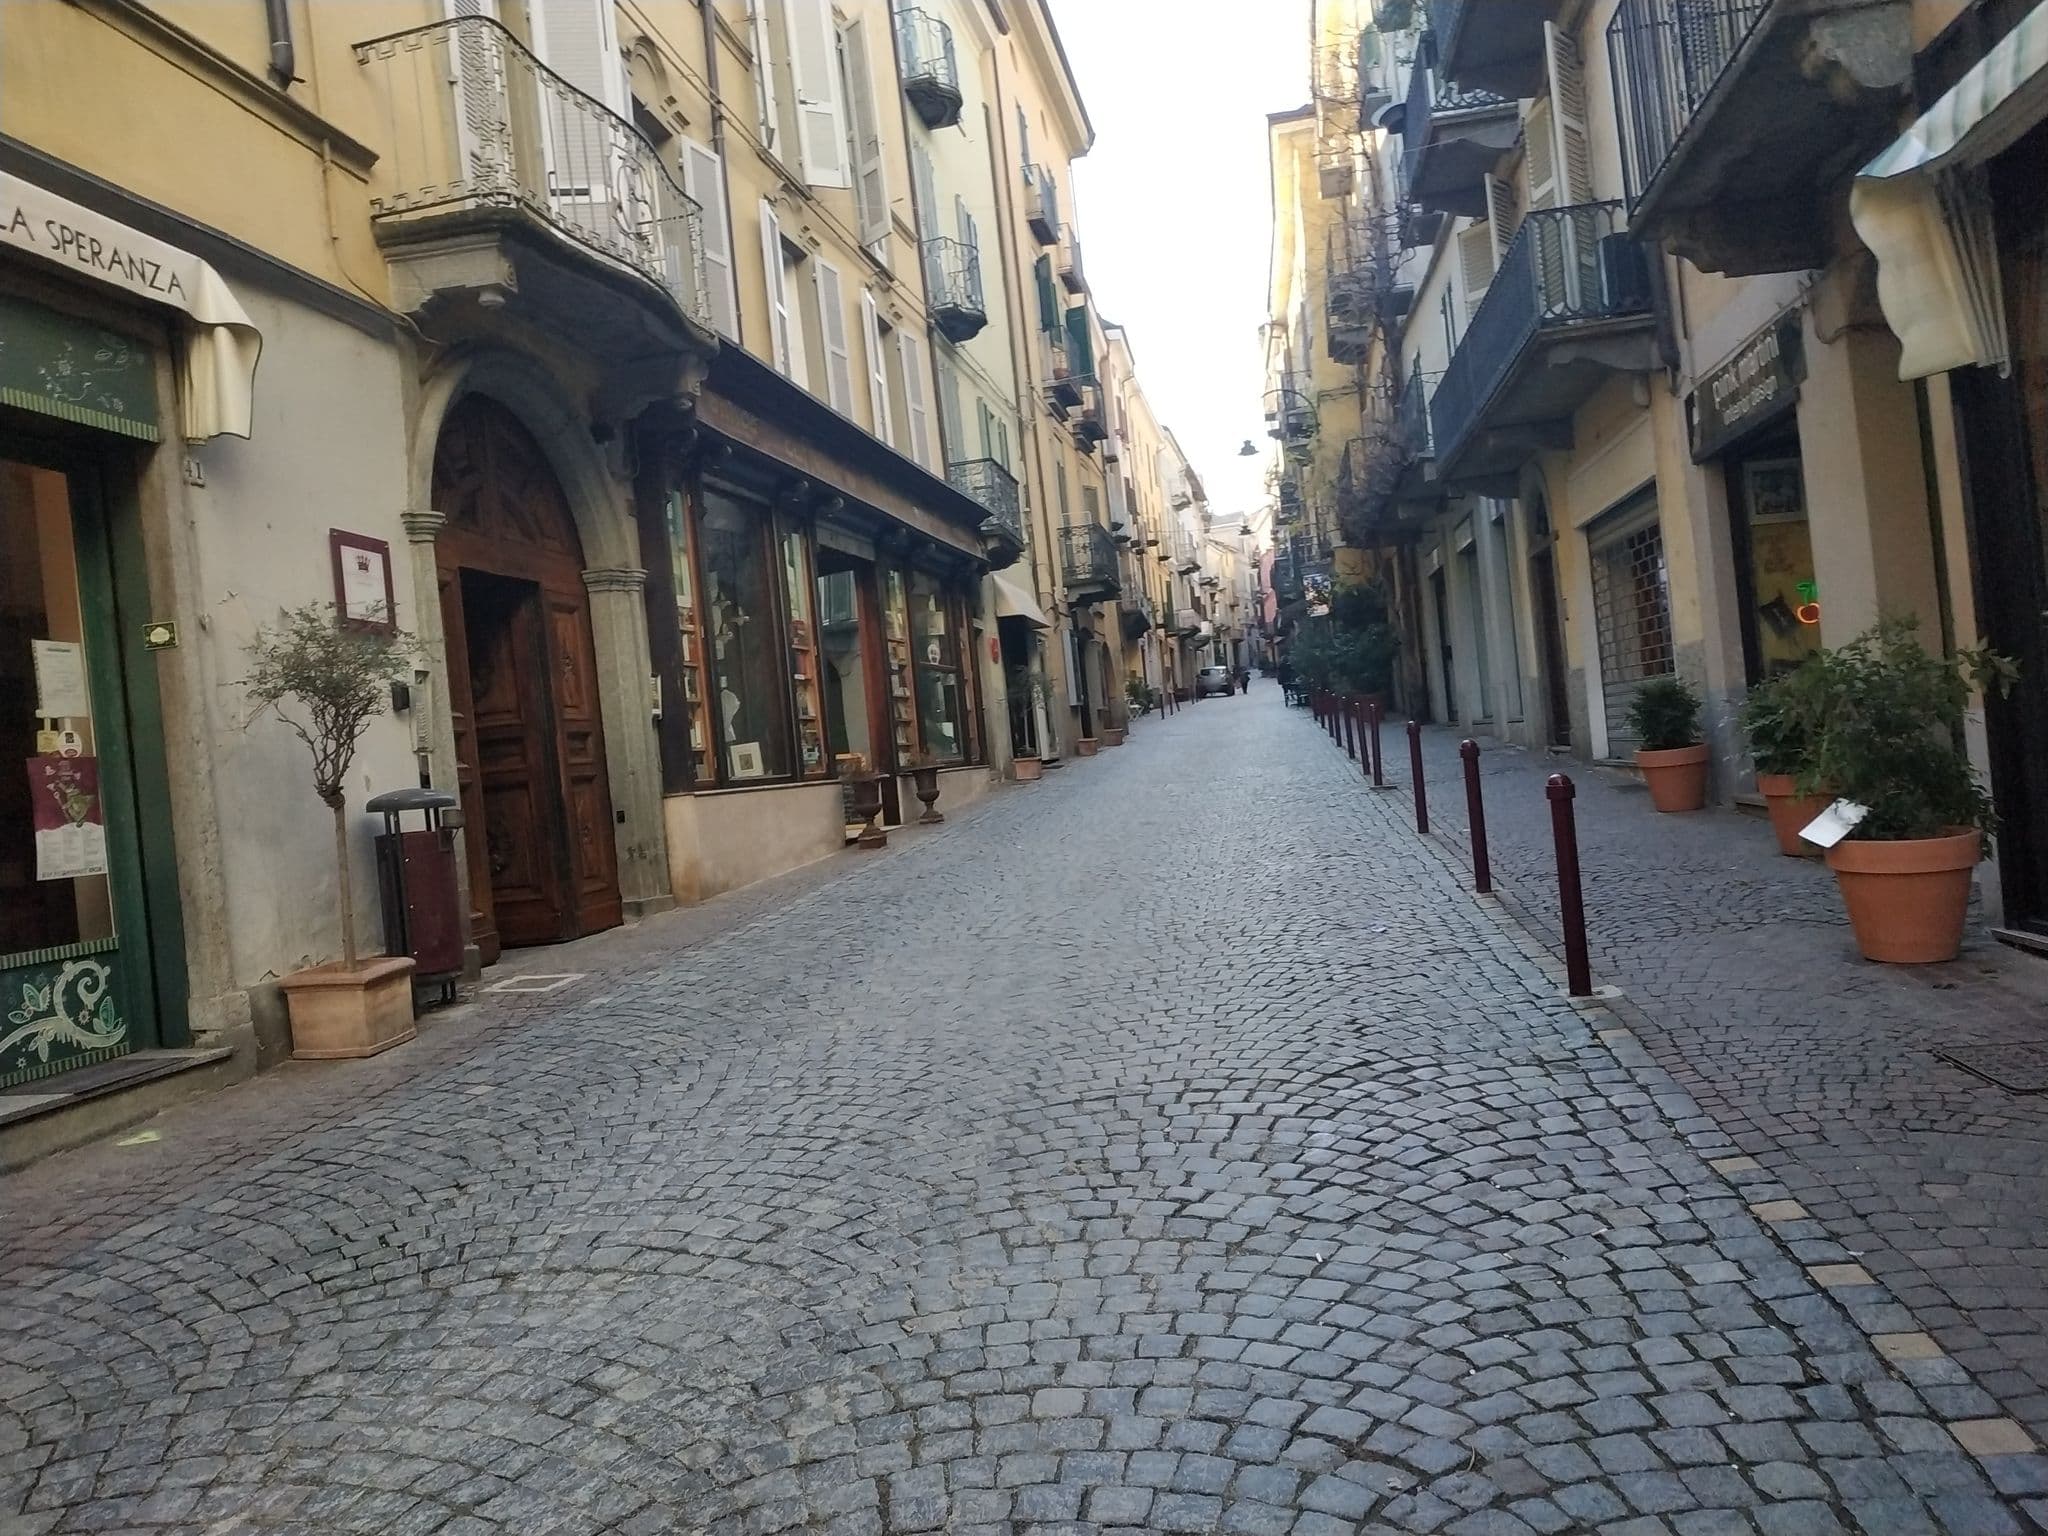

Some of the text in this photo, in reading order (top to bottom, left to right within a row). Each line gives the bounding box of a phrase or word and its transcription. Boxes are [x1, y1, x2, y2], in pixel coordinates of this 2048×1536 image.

[0, 206, 187, 302] A SPERANZA
[184, 459, 203, 480] 41
